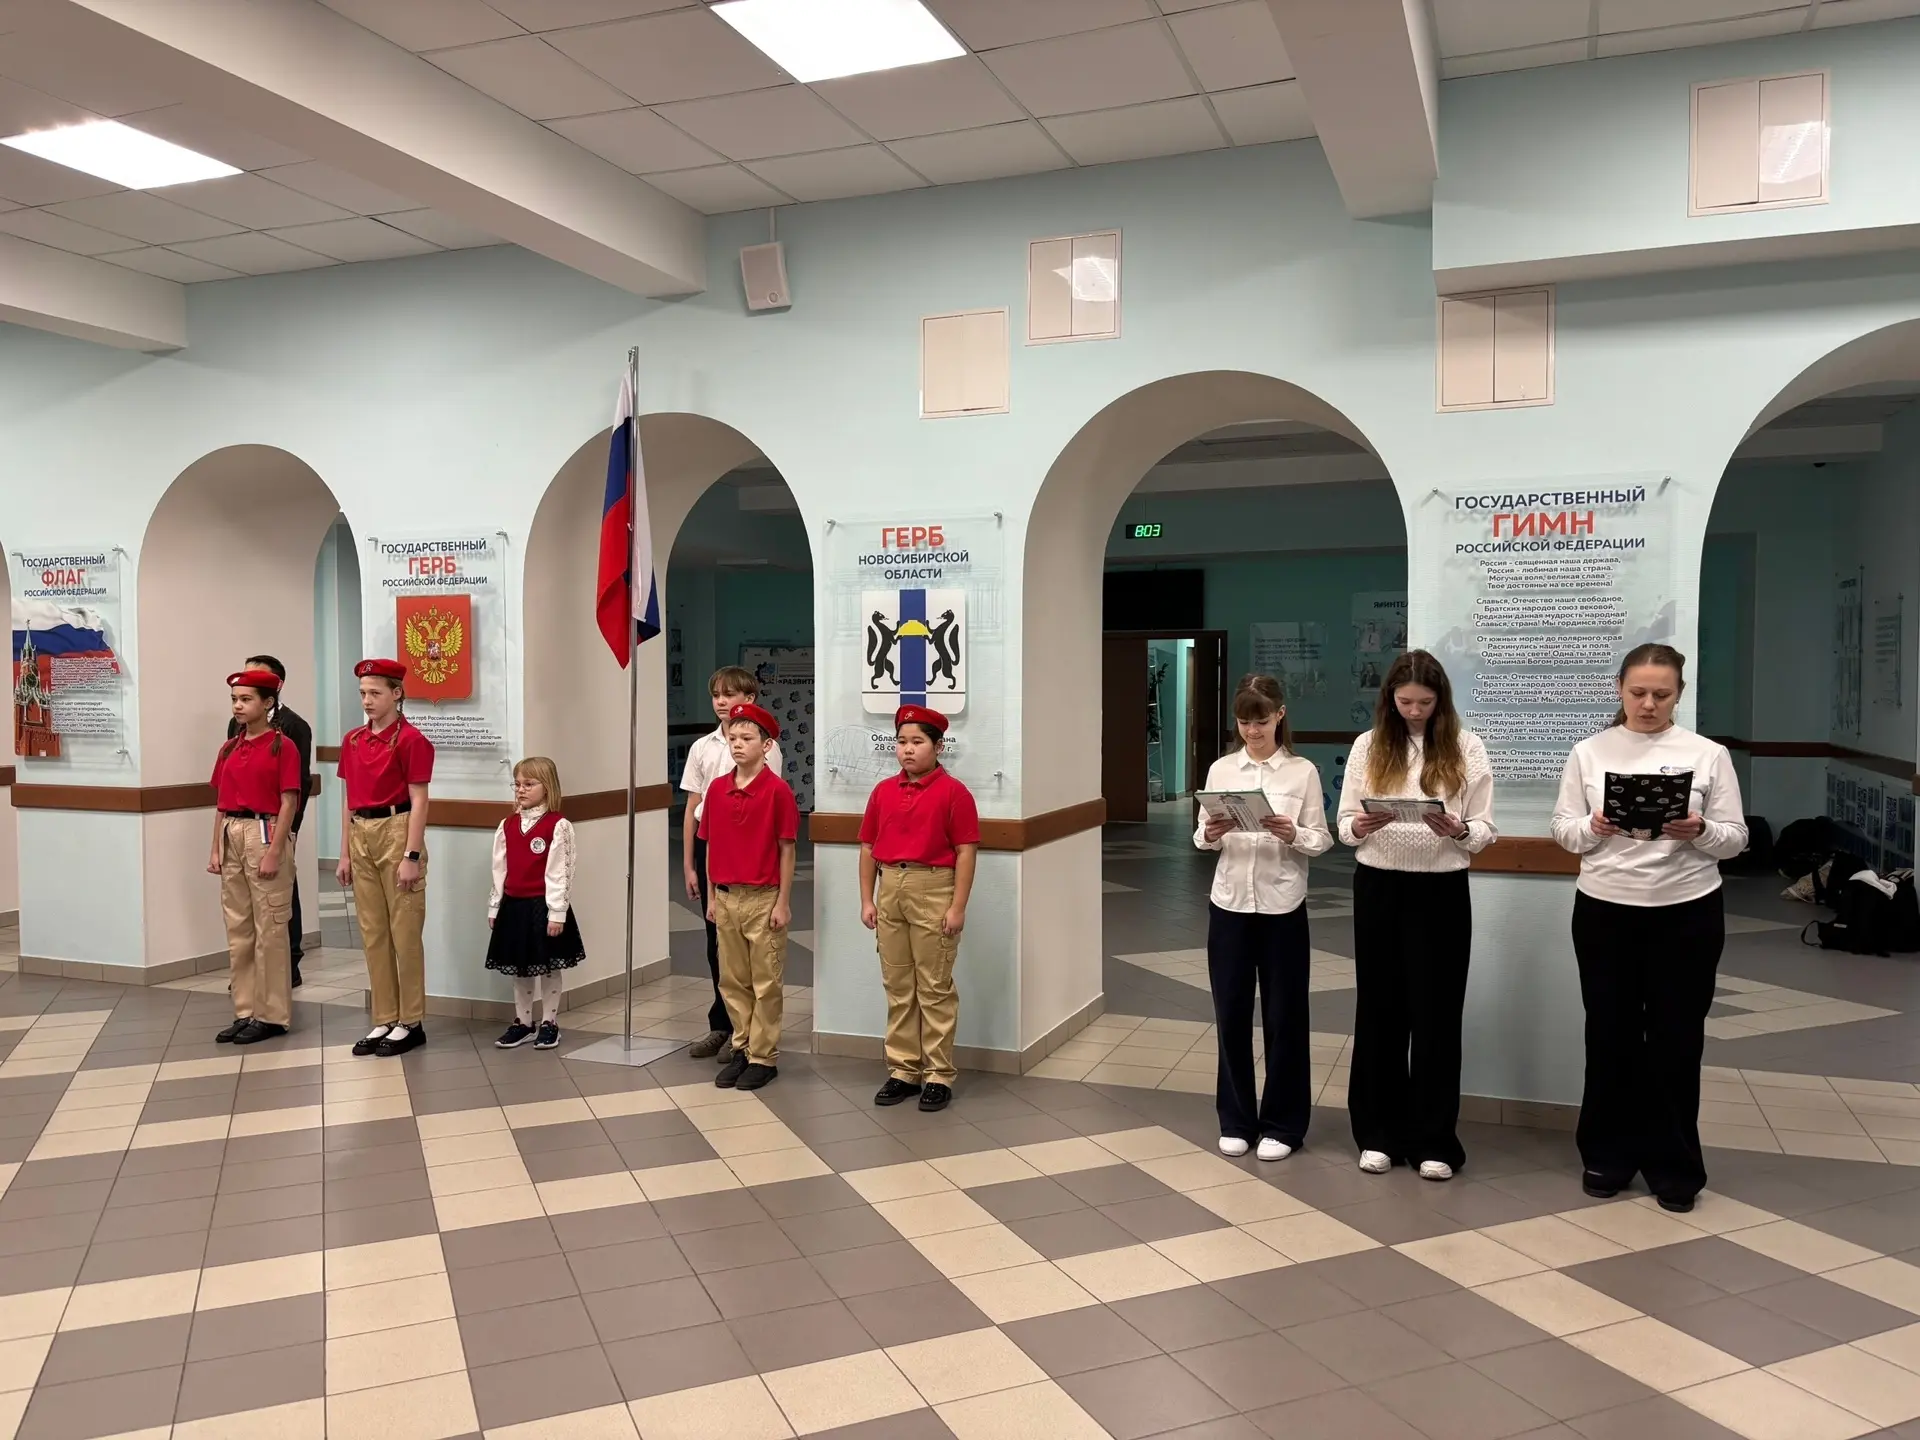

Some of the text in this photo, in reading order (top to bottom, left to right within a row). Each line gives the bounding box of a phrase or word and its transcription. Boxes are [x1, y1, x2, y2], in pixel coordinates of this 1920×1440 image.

[1456, 486, 1645, 510] ГОСУДАРСТВЕННЫЙ
[1493, 511, 1593, 537] ГИМН
[882, 526, 944, 548] ГЕРБ
[382, 538, 486, 554] ГОСУДАРСТВЕННЫЙ
[1456, 538, 1645, 554] РОССИЙСКОЙ ФЕДЕРАЦИИ
[23, 554, 105, 568] ГОСУДАРСТВЕННЫЙ
[859, 550, 968, 565] НОВОСИБИРСКОЙ
[409, 556, 456, 575] ГЕРБ
[42, 569, 85, 586] ФЛАГ
[383, 576, 487, 587] РОССИЙСКОЙ ФЕДЕРАЦИИ
[884, 569, 942, 579] ОБЛАСТИ
[25, 588, 106, 597] РОССИЙСКОЙ ФЕДЕРАЦИИ
[1486, 719, 1524, 727] Грядущие
[871, 734, 897, 742] Облас
